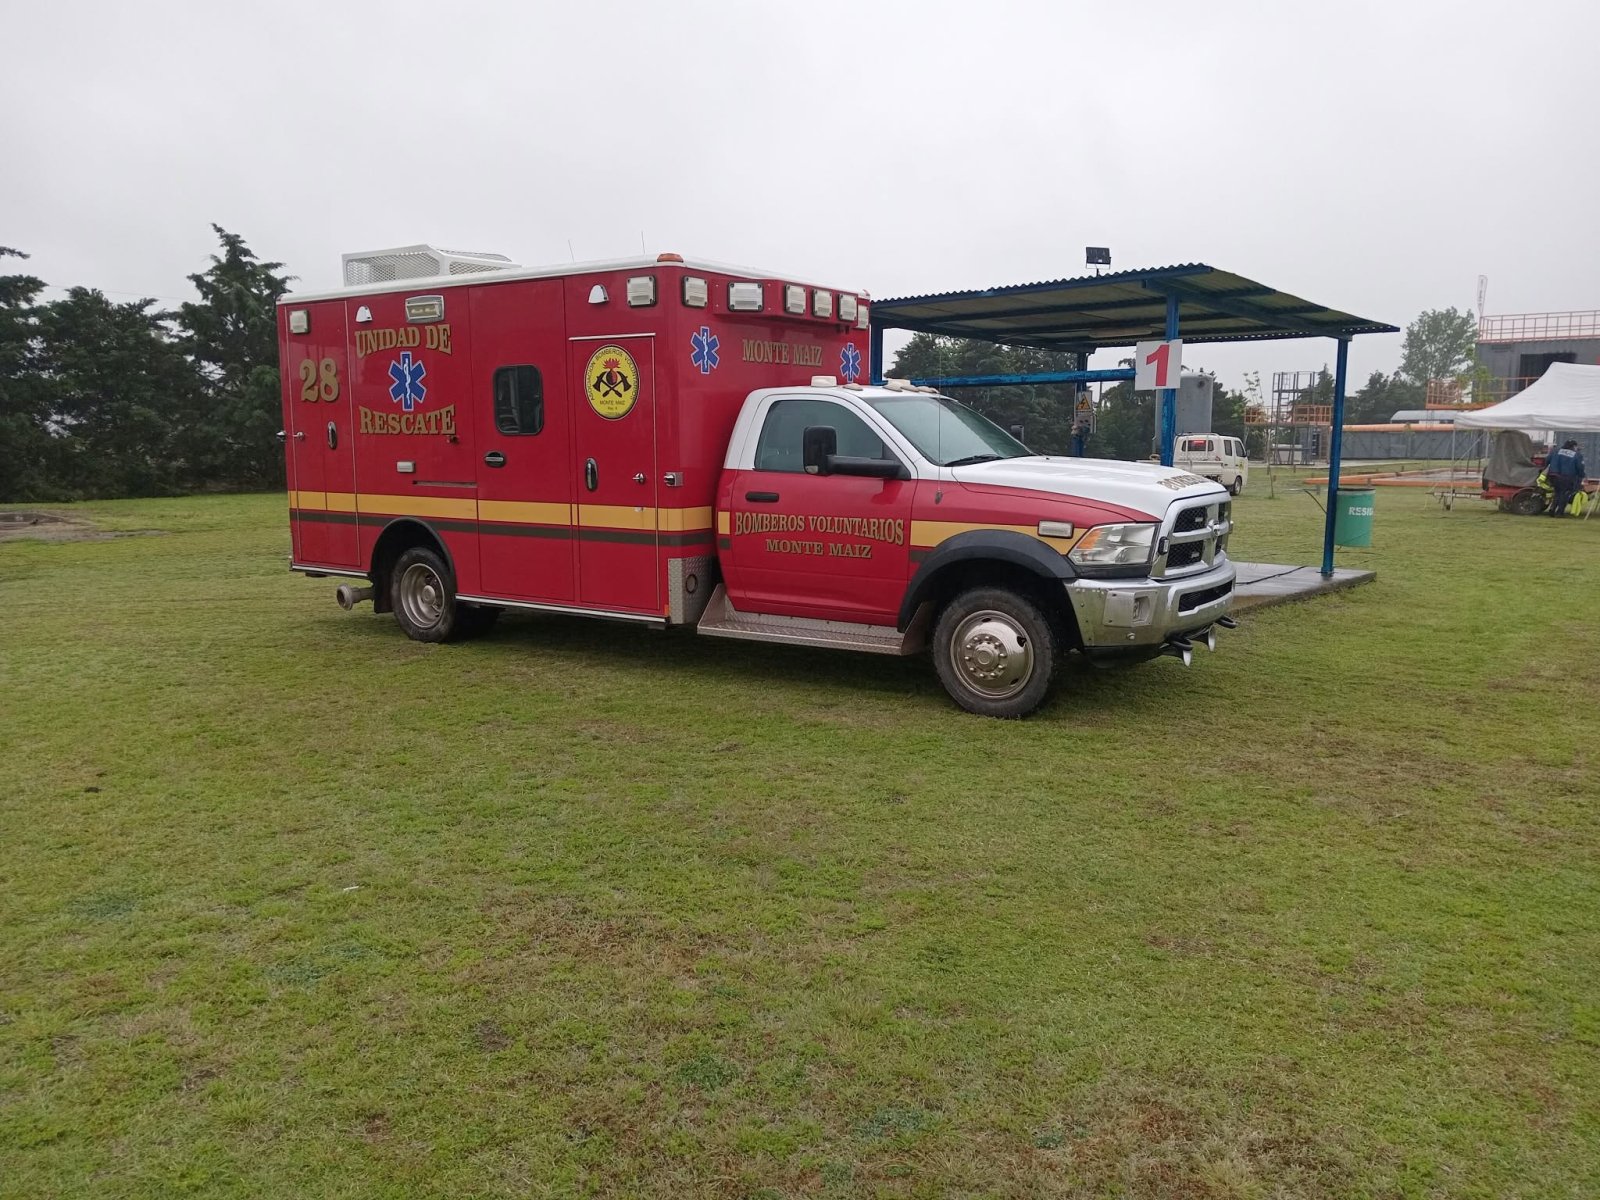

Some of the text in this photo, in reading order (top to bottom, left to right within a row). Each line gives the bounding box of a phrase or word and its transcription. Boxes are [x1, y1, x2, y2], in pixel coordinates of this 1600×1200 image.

[355, 324, 452, 358] UNIDAD DE
[596, 348, 624, 361] BOMBEROS
[743, 339, 823, 367] MONTE MAIZ
[300, 358, 340, 402] 28
[1146, 344, 1170, 387] 1
[359, 405, 456, 435] RESCATE
[735, 511, 905, 546] BOMBEROS VOLUNTARIOS
[766, 539, 873, 559] MONTE MAIZ
